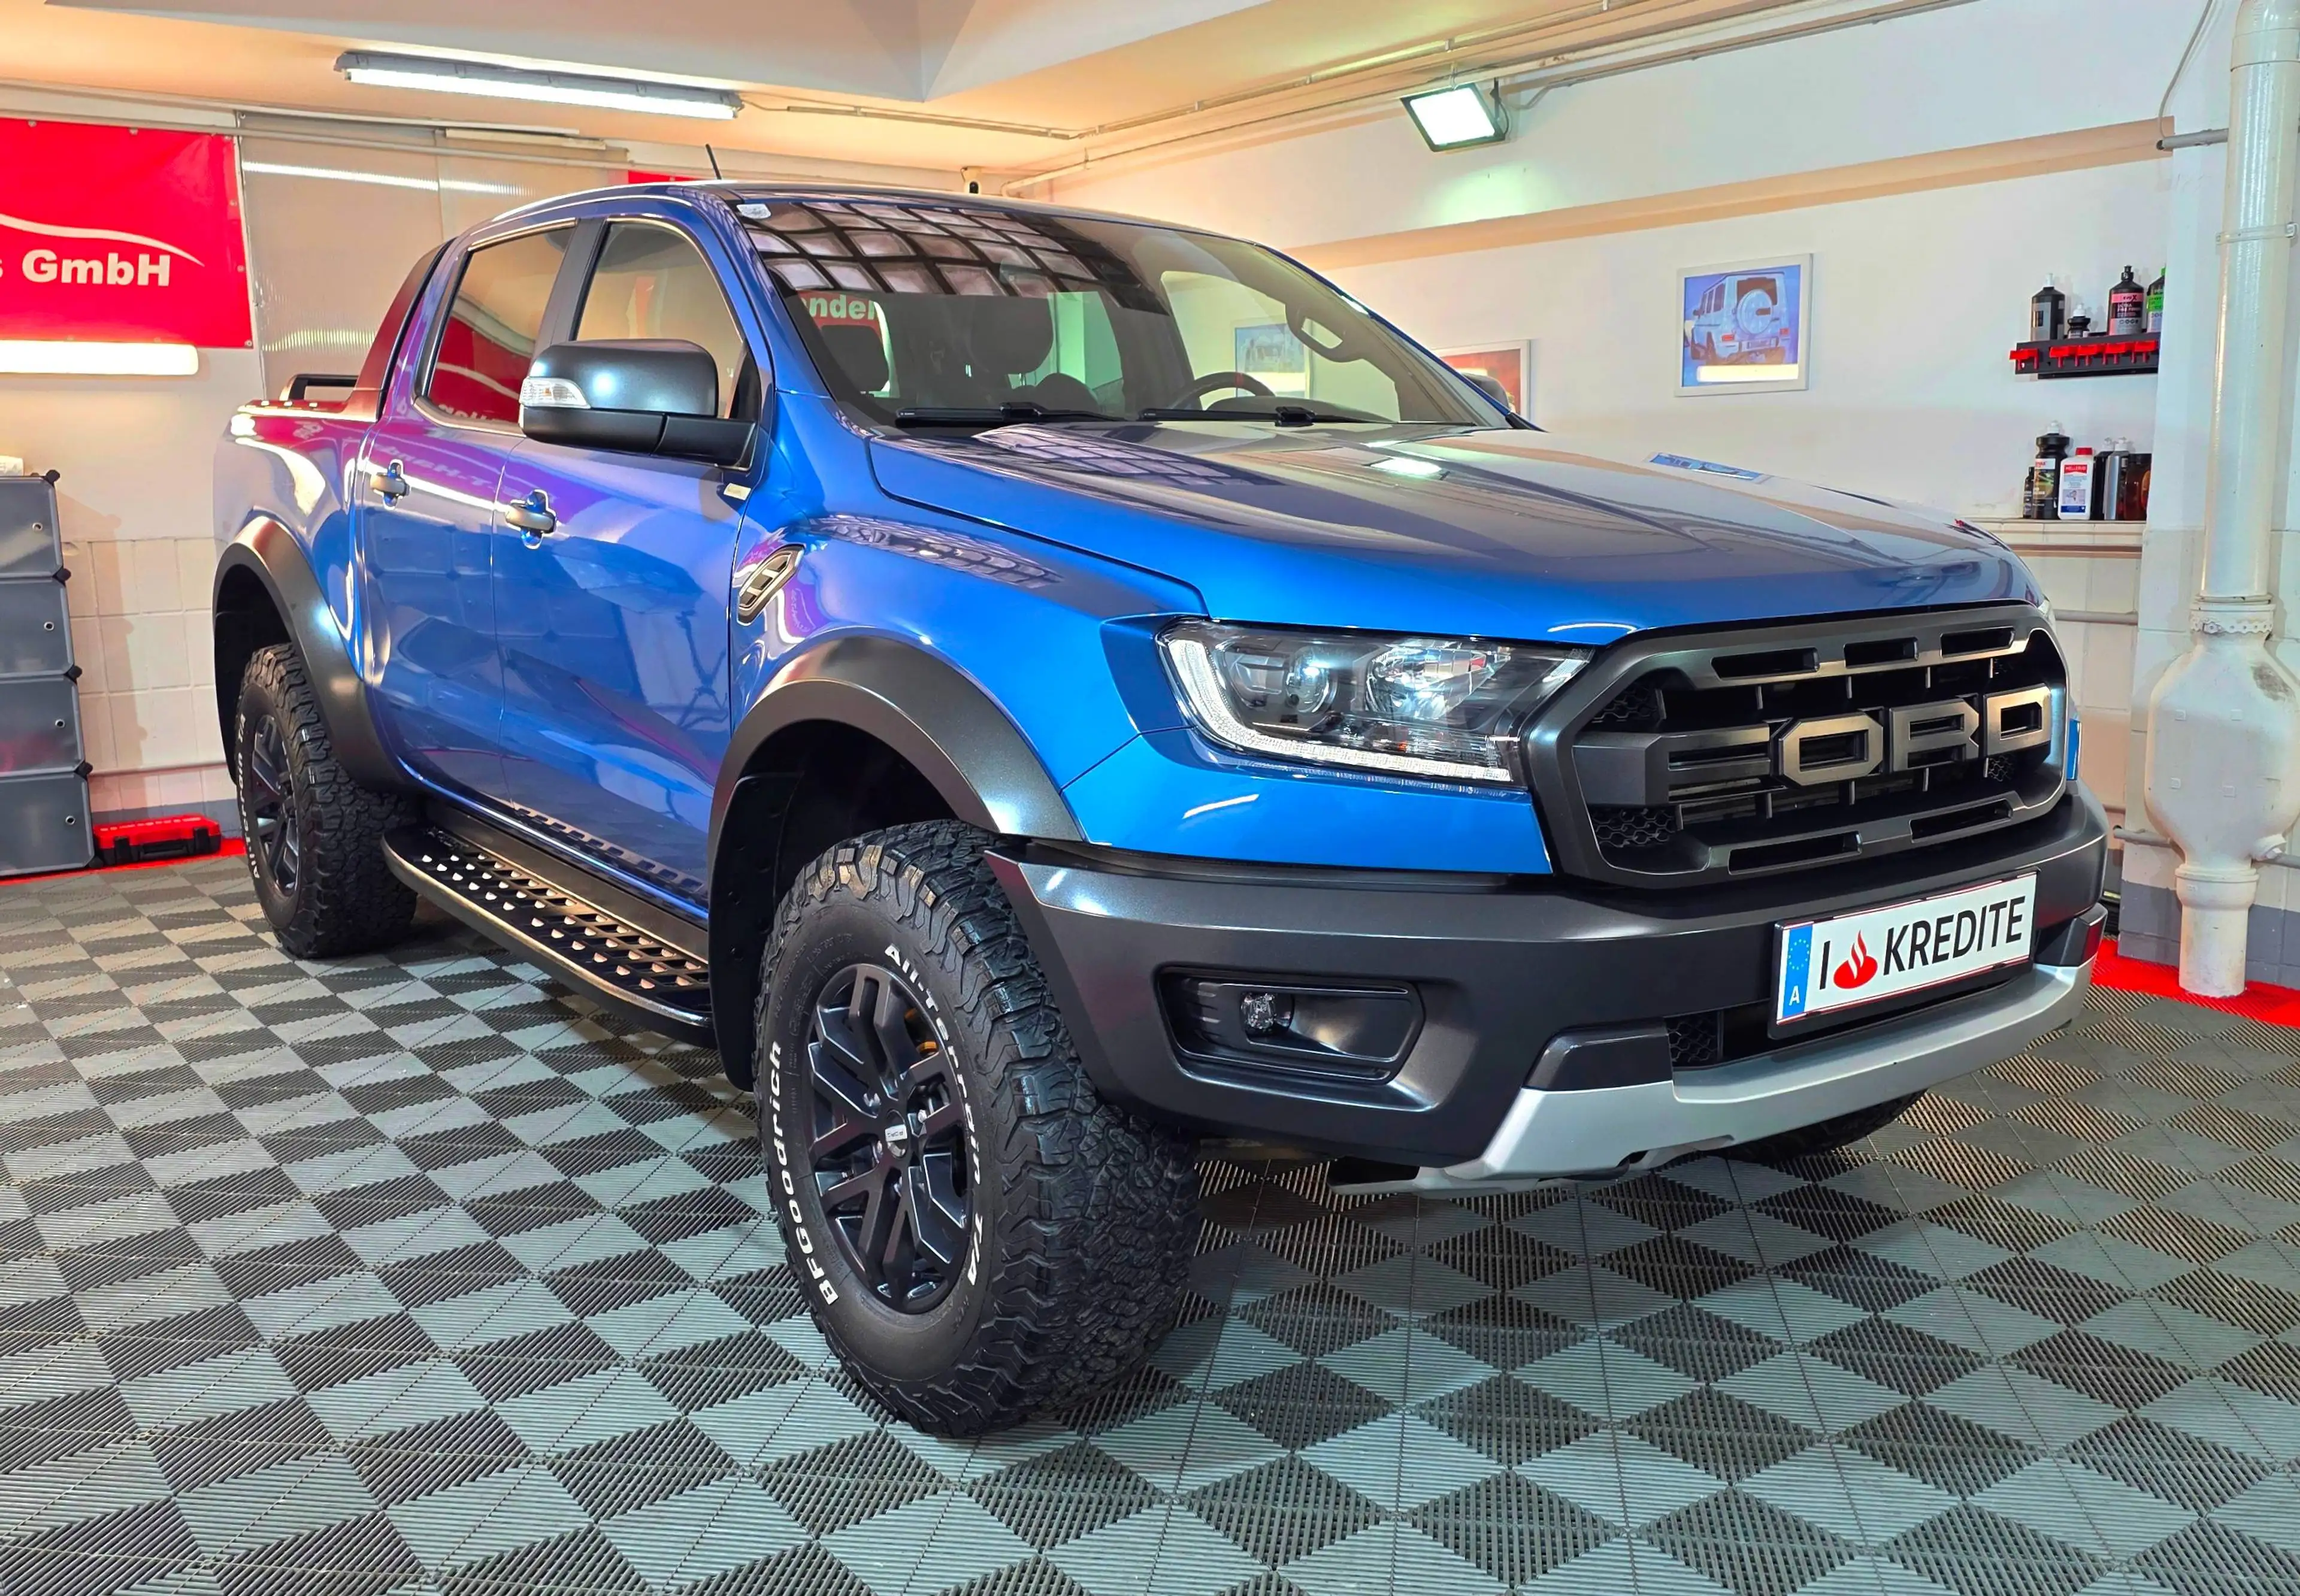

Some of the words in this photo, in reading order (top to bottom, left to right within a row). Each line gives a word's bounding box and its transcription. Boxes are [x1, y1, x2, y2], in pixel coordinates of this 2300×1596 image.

[22, 249, 171, 287] GmbH
[1644, 682, 2053, 807] FORD
[1788, 985, 1800, 1007] A
[1818, 940, 1830, 991] I
[1883, 895, 2026, 976] KREDITE
[884, 943, 980, 1185] All-Terrain
[967, 1212, 983, 1286] T/A
[768, 1040, 839, 1306] BFGoodrich
